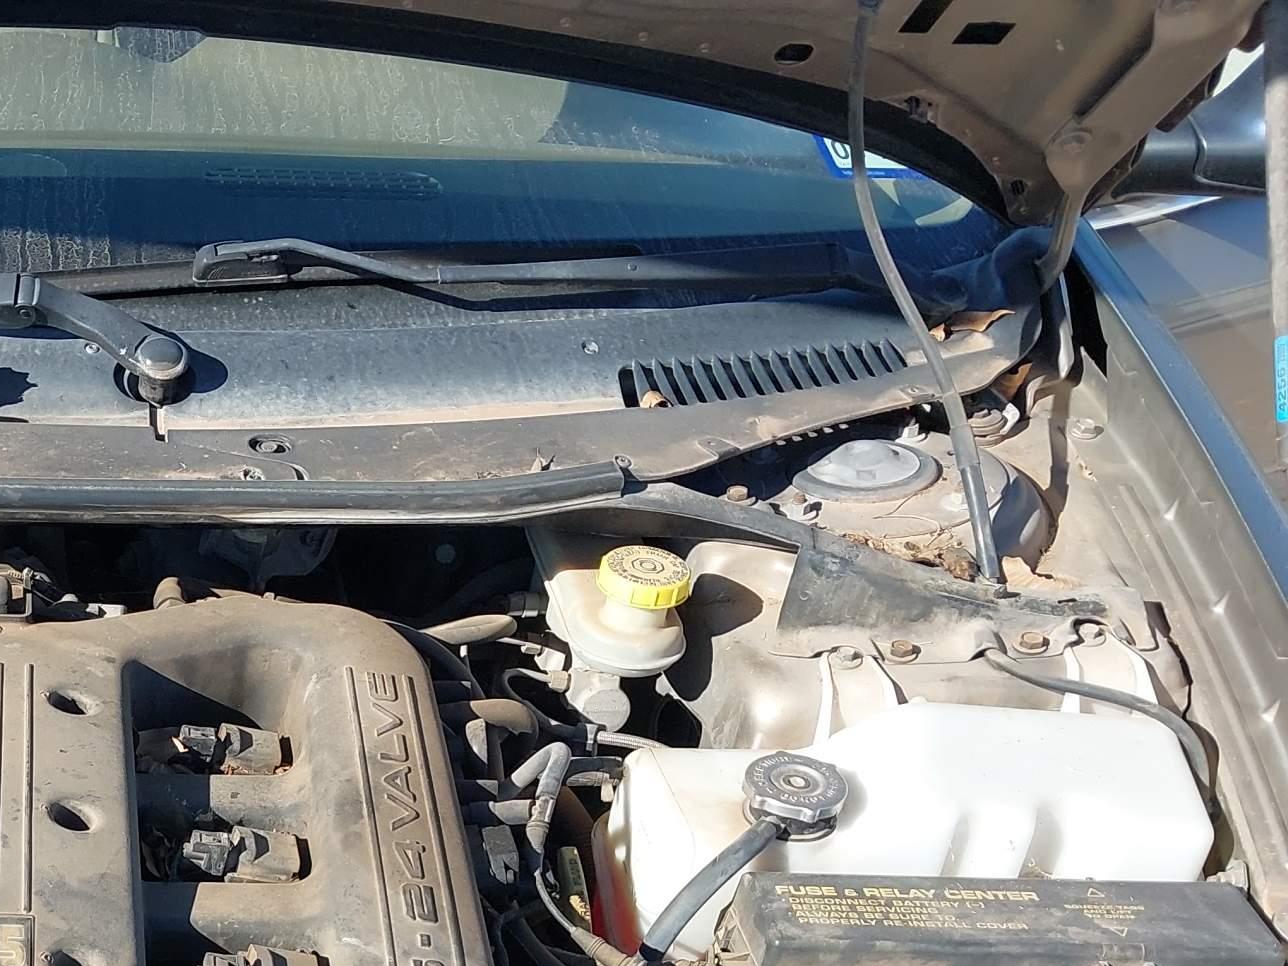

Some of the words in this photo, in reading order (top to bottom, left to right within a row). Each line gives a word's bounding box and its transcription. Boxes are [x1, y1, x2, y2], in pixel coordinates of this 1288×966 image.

[366, 671, 421, 832] VALVE
[775, 885, 838, 896] FUSE
[846, 889, 859, 897] &
[863, 887, 936, 899] RELAY
[944, 889, 1040, 901] CENTER
[790, 897, 887, 906] DISCONNECT
[893, 899, 959, 908] BATTERY
[792, 904, 848, 913] BEFORE
[851, 906, 938, 914] SERVICING
[796, 910, 859, 919] ALWAYS
[864, 912, 883, 920] BE
[890, 913, 935, 921] SURE
[798, 917, 877, 927] PROPERLY
[883, 919, 971, 928] RE-INSTALL
[976, 922, 1029, 930] COVER
